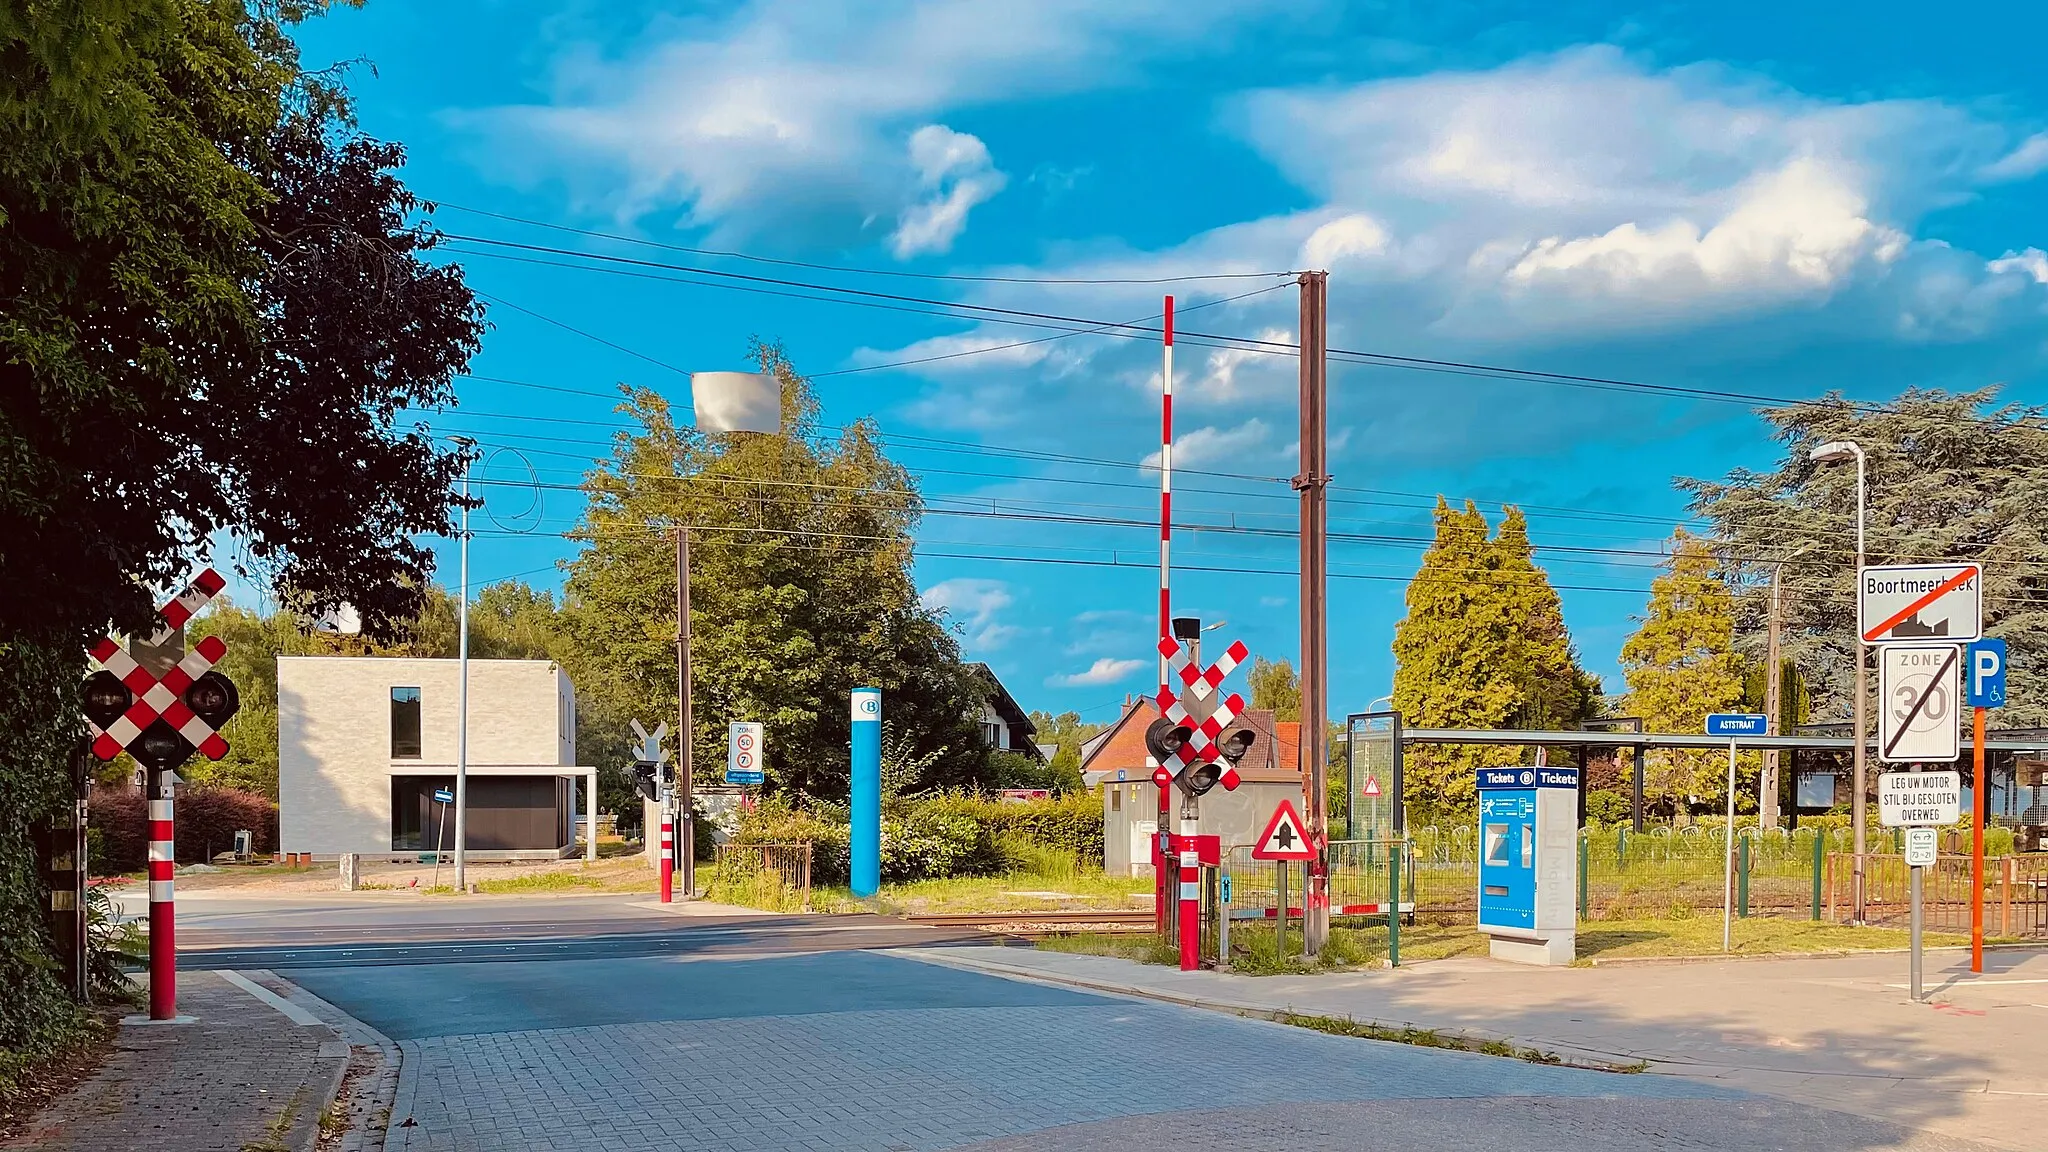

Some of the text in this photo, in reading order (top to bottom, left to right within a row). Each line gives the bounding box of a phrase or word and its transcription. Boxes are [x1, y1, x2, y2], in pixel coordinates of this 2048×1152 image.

[1867, 575, 1974, 594] Boortmeerbek
[1900, 654, 1941, 666] ZONE
[1975, 650, 2000, 696] P
[1895, 686, 1947, 720] 30
[1720, 720, 1756, 729] ASTSTRAAT
[1487, 773, 1515, 784] Tickets
[1540, 772, 1577, 785] Tickets
[1891, 776, 1950, 789] LEG UW MOTOR
[1883, 792, 1957, 806] STIL BIJ GESLOTEN
[1901, 808, 1940, 821] OVERWEG
